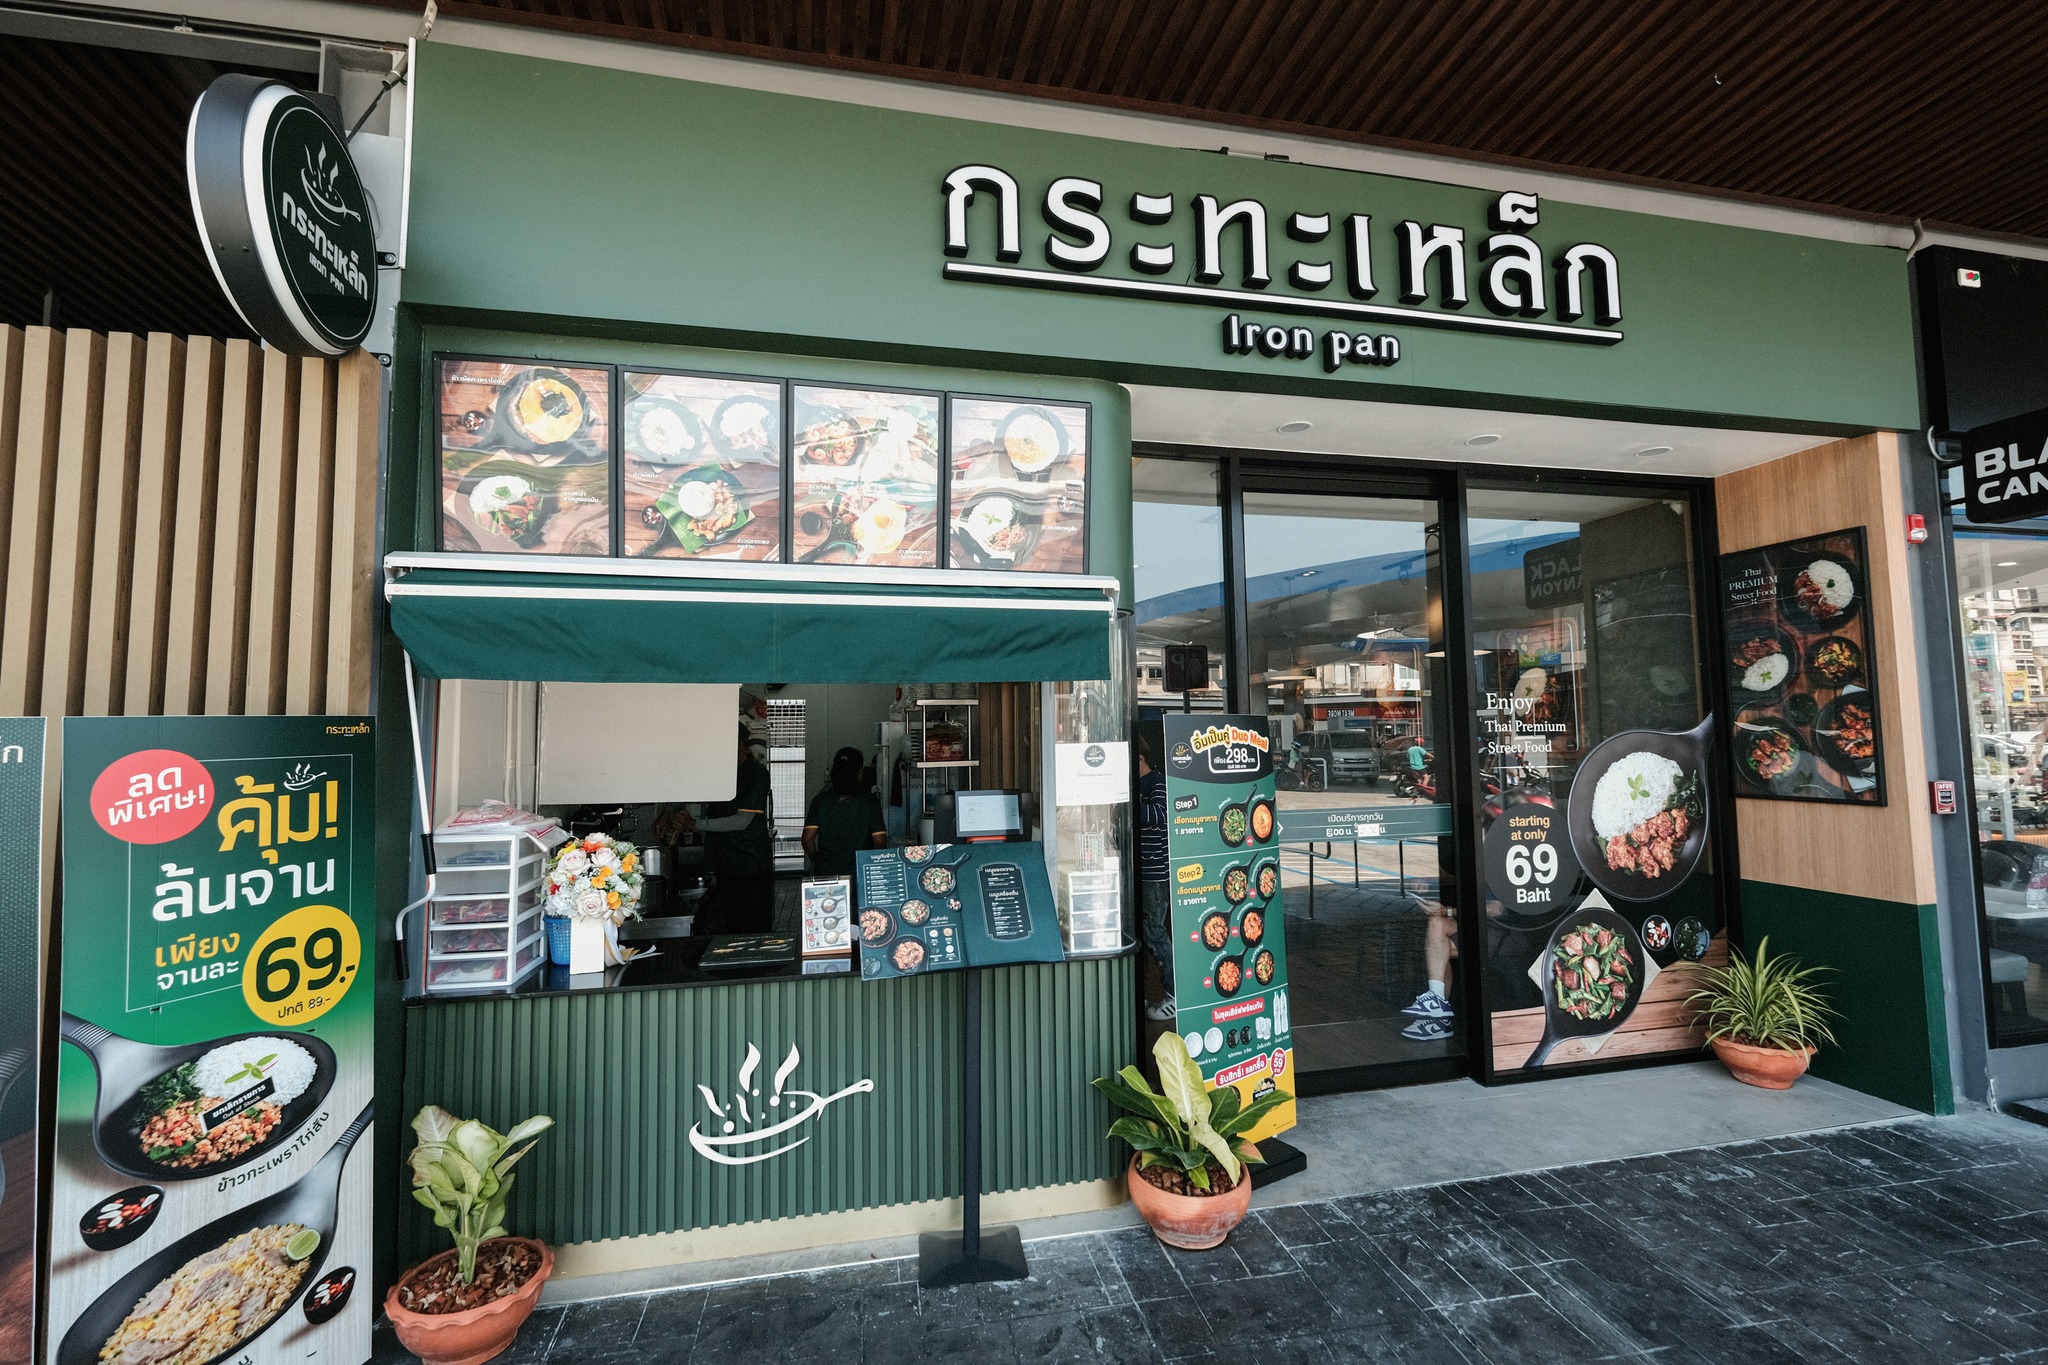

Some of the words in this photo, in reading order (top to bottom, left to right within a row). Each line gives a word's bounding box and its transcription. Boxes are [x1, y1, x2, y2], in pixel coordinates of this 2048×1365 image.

[282, 192, 368, 301] กระทะเหล็ก
[944, 164, 1623, 325] กระทะเหล็ก
[309, 251, 327, 278] IRON
[330, 272, 345, 295] PAN
[1227, 314, 1313, 353] Iron
[1329, 329, 1400, 369] pan
[1742, 567, 1762, 577] Thai
[1728, 575, 1779, 591] PREMIUM
[1731, 588, 1755, 602] Street
[1756, 586, 1778, 598] Food
[1485, 692, 1535, 715] Enjoy
[325, 722, 370, 735] กระทะเหล็ก
[1484, 720, 1514, 733] Thai
[1515, 720, 1567, 733] Premium
[1193, 726, 1231, 750] อิ่มเป็นคู่
[1231, 729, 1249, 742] Duo
[1250, 730, 1268, 751] Meal
[1487, 741, 1523, 754] Street
[1524, 740, 1553, 753] Food
[1225, 747, 1248, 764] 298
[127, 767, 183, 798] ลด
[107, 784, 206, 826] พิเศษ!
[217, 775, 339, 865] คุ้ม!
[1174, 815, 1218, 826] เลือกเมนูอาหาร
[1327, 812, 1384, 823] เปิดบริการทุกวัน
[1509, 815, 1550, 829] starting
[1180, 827, 1204, 835] รายการ
[1510, 831, 1522, 841] at
[1523, 829, 1547, 842] only
[1505, 843, 1559, 886] 69
[152, 858, 335, 922] ล้นจาน
[1177, 884, 1221, 895] เลือกเมนูอาหาร
[1516, 887, 1551, 904] Baht
[1183, 897, 1207, 905] รายการ
[155, 932, 241, 968] เพียง
[157, 958, 240, 991] จานละ
[278, 1000, 304, 1019] ปกติ
[1273, 1058, 1284, 1067] 59
[212, 1084, 267, 1118] ยกเลิกรายการ
[222, 1110, 235, 1120] Out
[243, 1095, 261, 1108] Stock
[217, 1110, 331, 1193] ข้าวกะเพราไก่สับ
